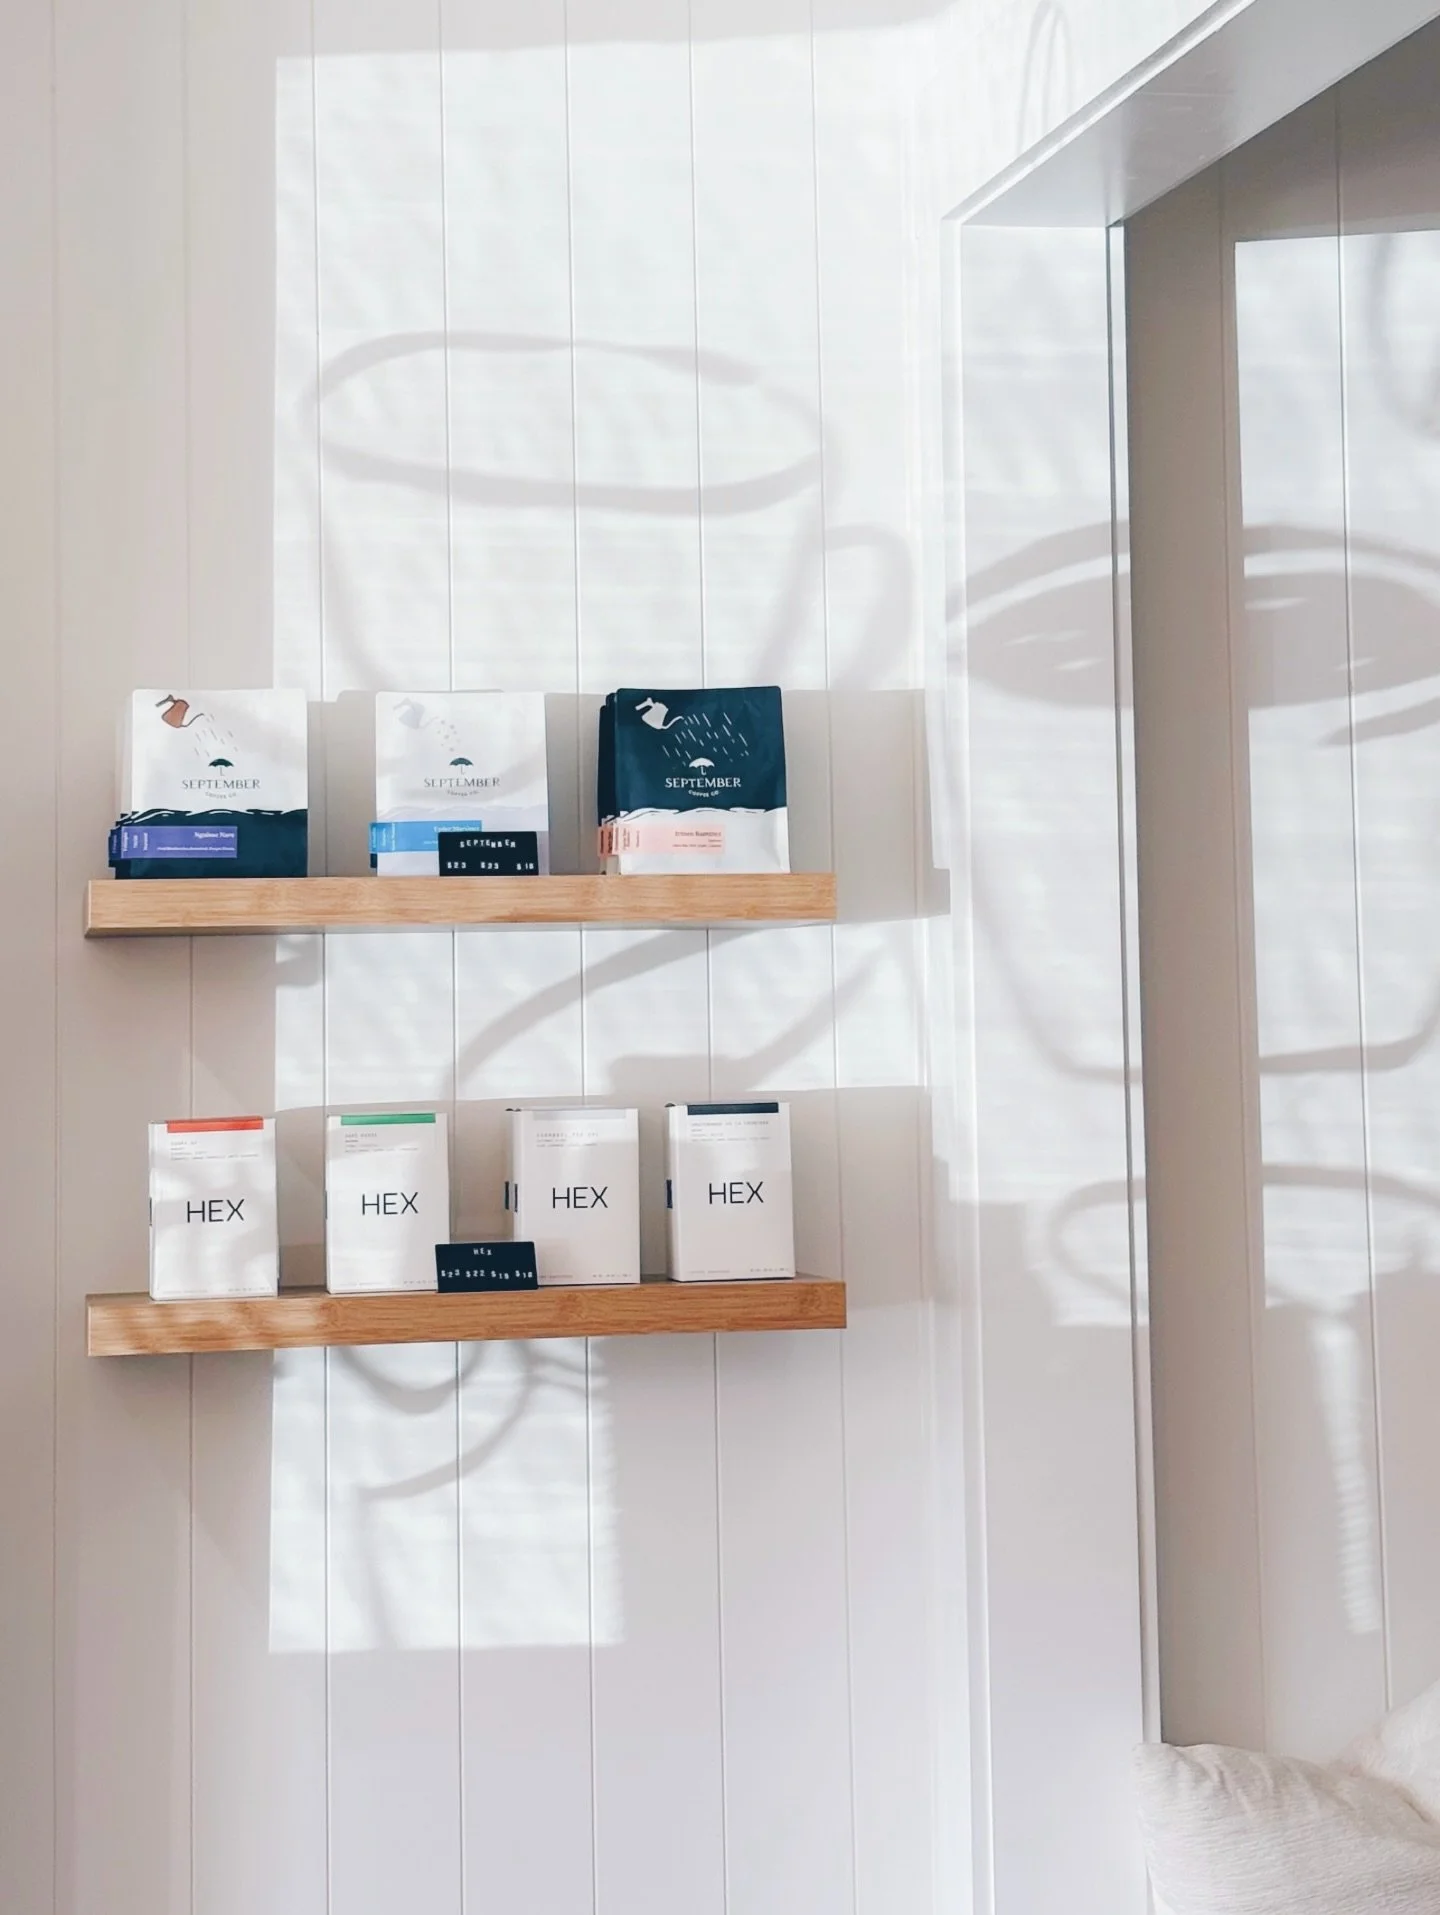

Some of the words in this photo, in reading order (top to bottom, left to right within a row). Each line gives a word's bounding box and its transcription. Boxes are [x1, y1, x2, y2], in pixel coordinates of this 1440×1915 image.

[182, 779, 260, 789] SEPTEMBER
[424, 778, 499, 788] SEPTEMBER
[665, 777, 741, 788] SEPTEMBER
[459, 839, 516, 849] SEPTEMBER
[552, 1186, 608, 1209] HEX
[708, 1181, 764, 1205] HEX
[186, 1198, 245, 1223] HEX
[362, 1191, 419, 1215] HEX
